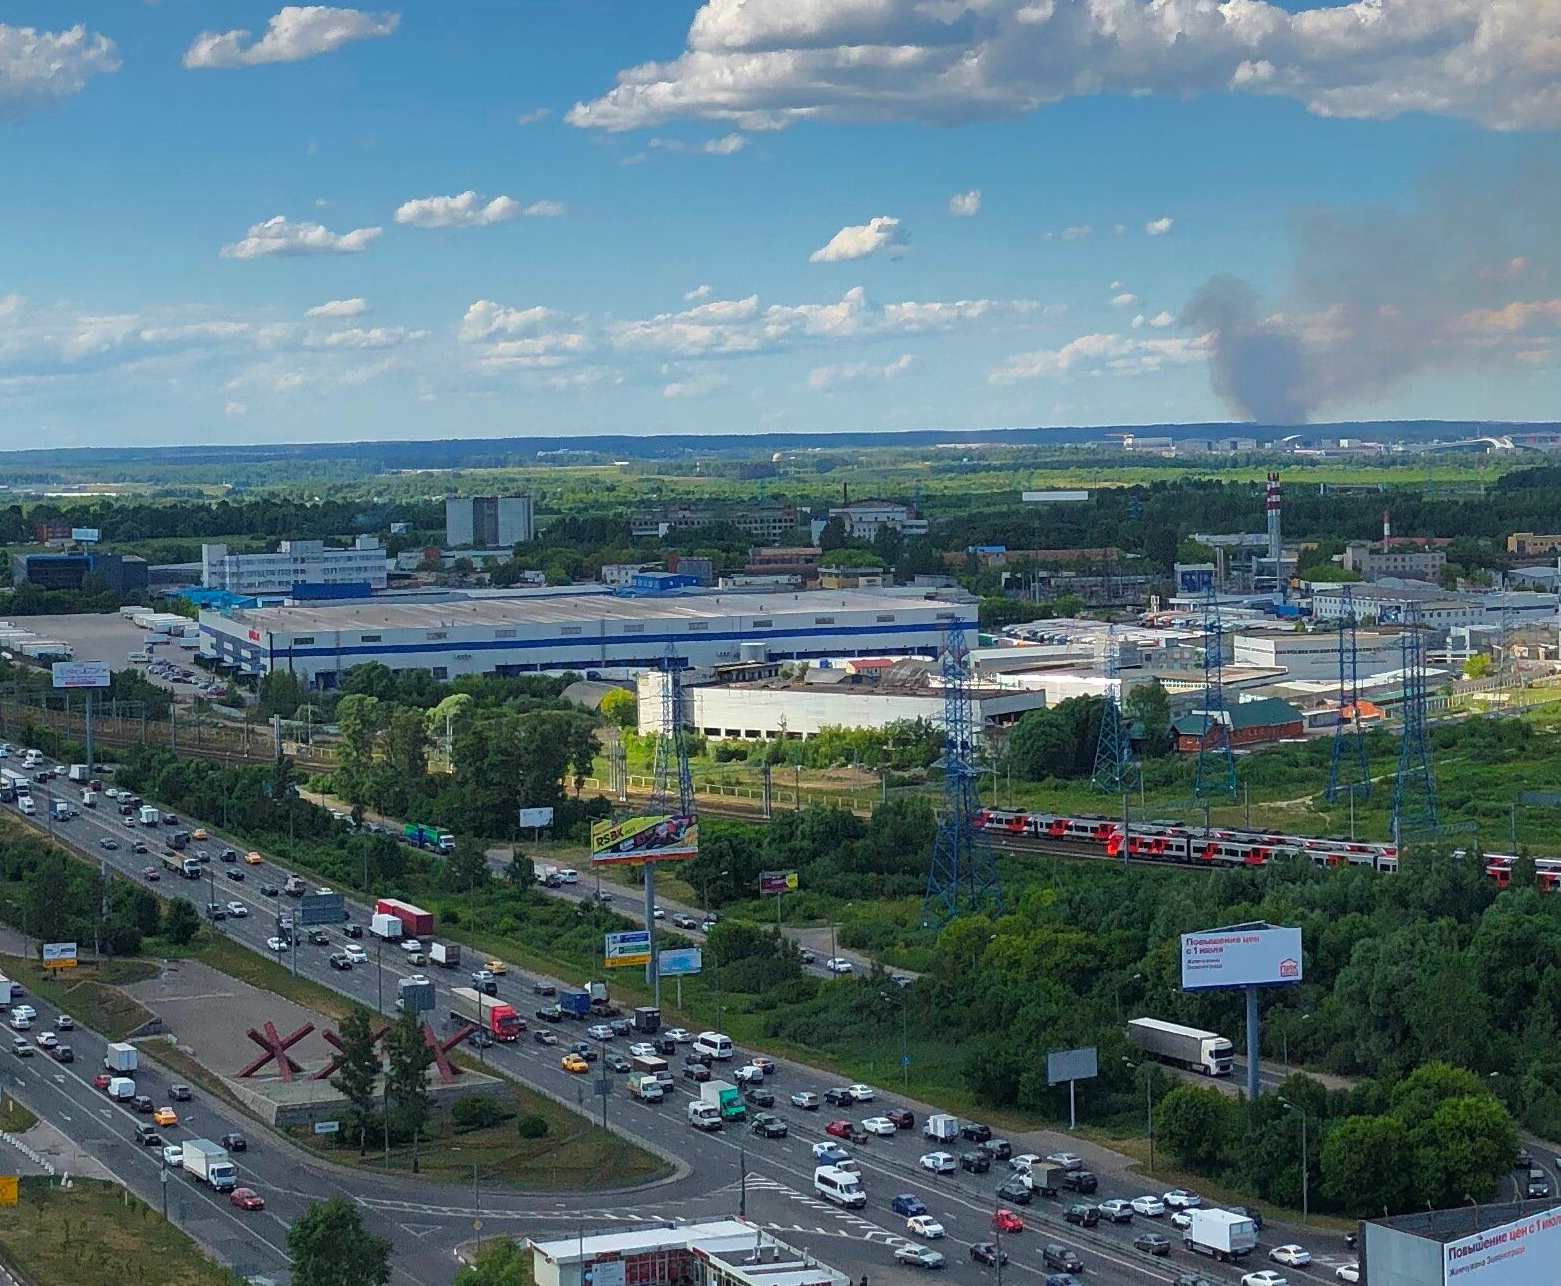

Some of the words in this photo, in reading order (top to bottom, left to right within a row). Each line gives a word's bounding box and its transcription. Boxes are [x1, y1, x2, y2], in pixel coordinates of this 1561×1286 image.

[1186, 936, 1241, 946] Повышение
[1242, 935, 1260, 945] цен
[1199, 946, 1224, 954] июля
[1448, 1232, 1508, 1261] Повышение
[1509, 1227, 1528, 1241] цен
[1528, 1225, 1535, 1234] с
[1536, 1218, 1541, 1231] 1
